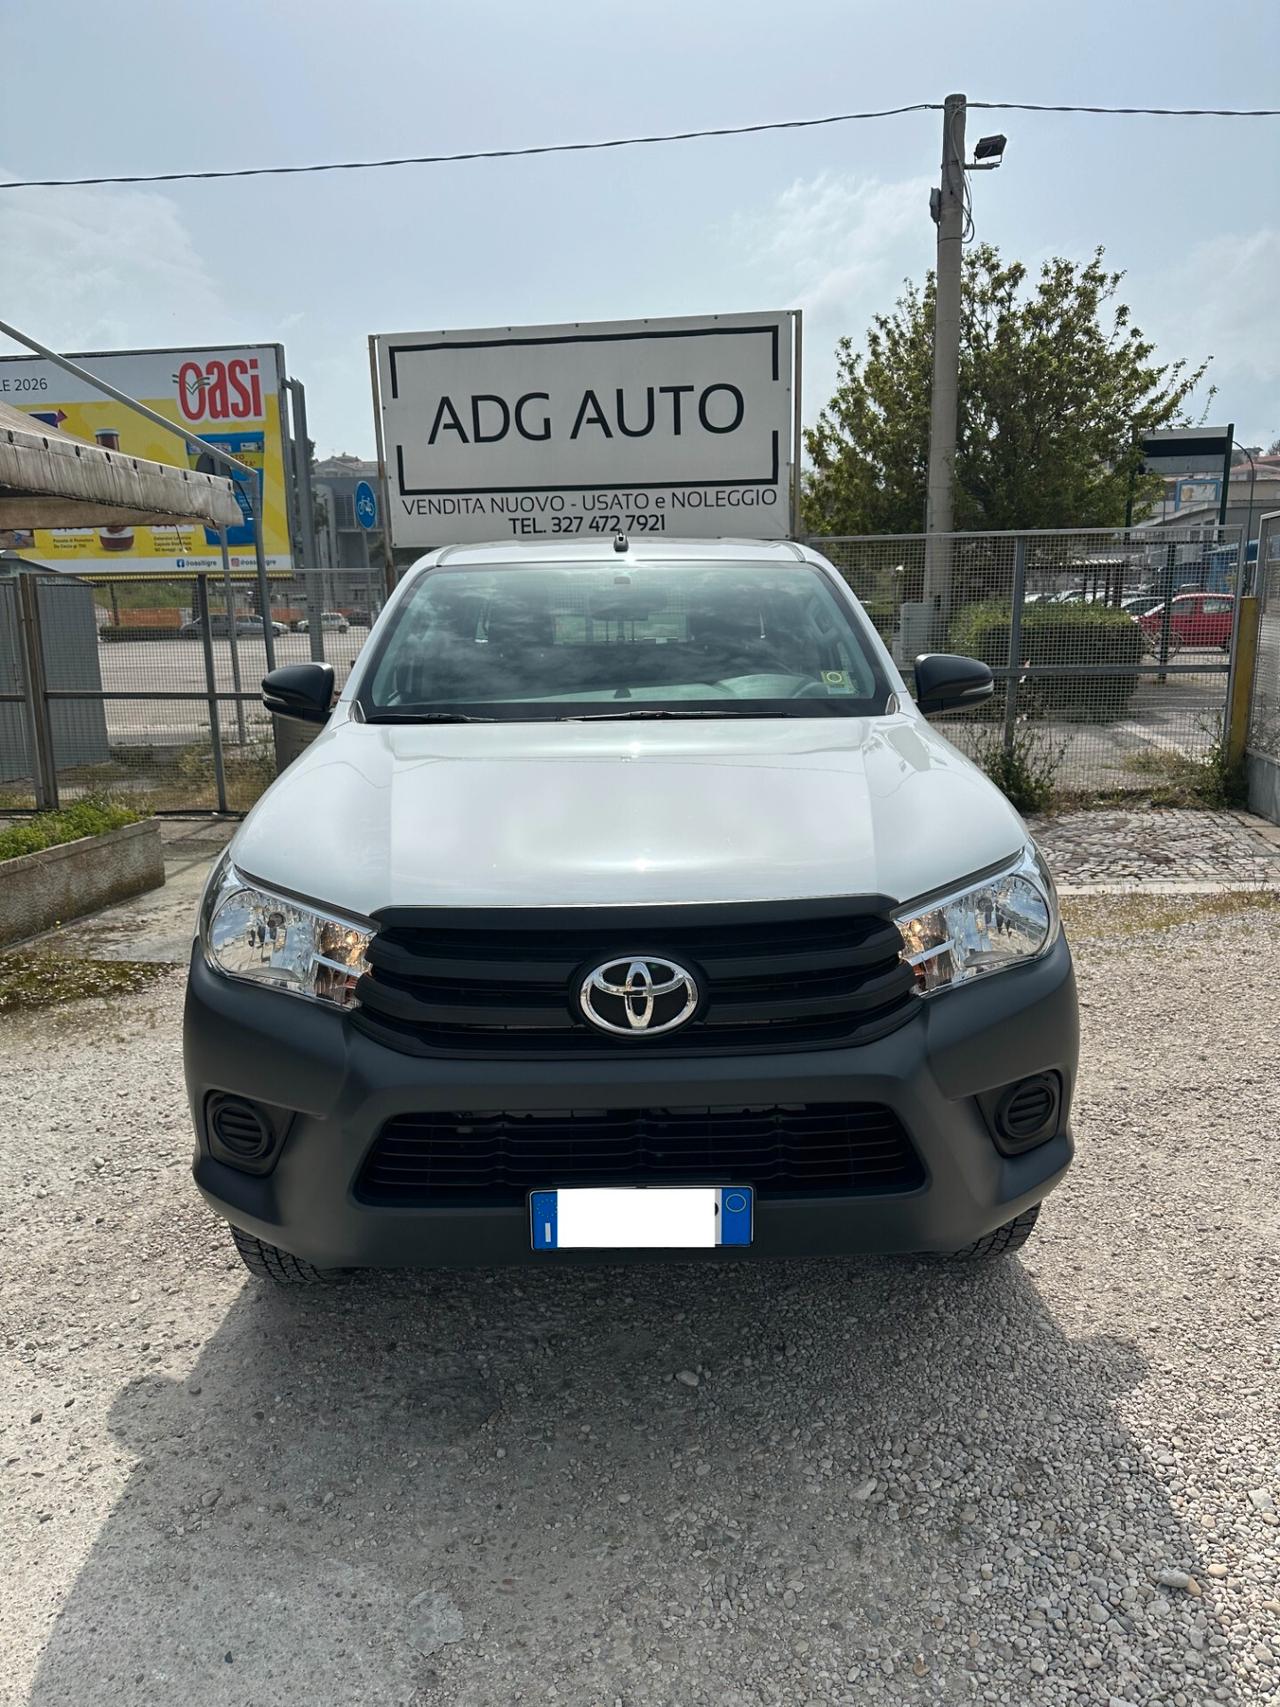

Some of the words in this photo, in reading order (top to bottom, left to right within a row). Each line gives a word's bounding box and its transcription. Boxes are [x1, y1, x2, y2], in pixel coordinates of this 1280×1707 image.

[14, 377, 48, 391] 2026
[428, 392, 551, 445] ADG
[570, 383, 745, 440] AUTO
[401, 497, 486, 516] VENDITA
[491, 495, 565, 513] NUOVO
[583, 493, 649, 511] USATO
[655, 496, 666, 509] e
[671, 488, 777, 509] NOLEGGIO
[508, 517, 547, 535] TEL.
[551, 516, 583, 534] 327
[588, 515, 621, 533] 472
[624, 513, 666, 532] 7921
